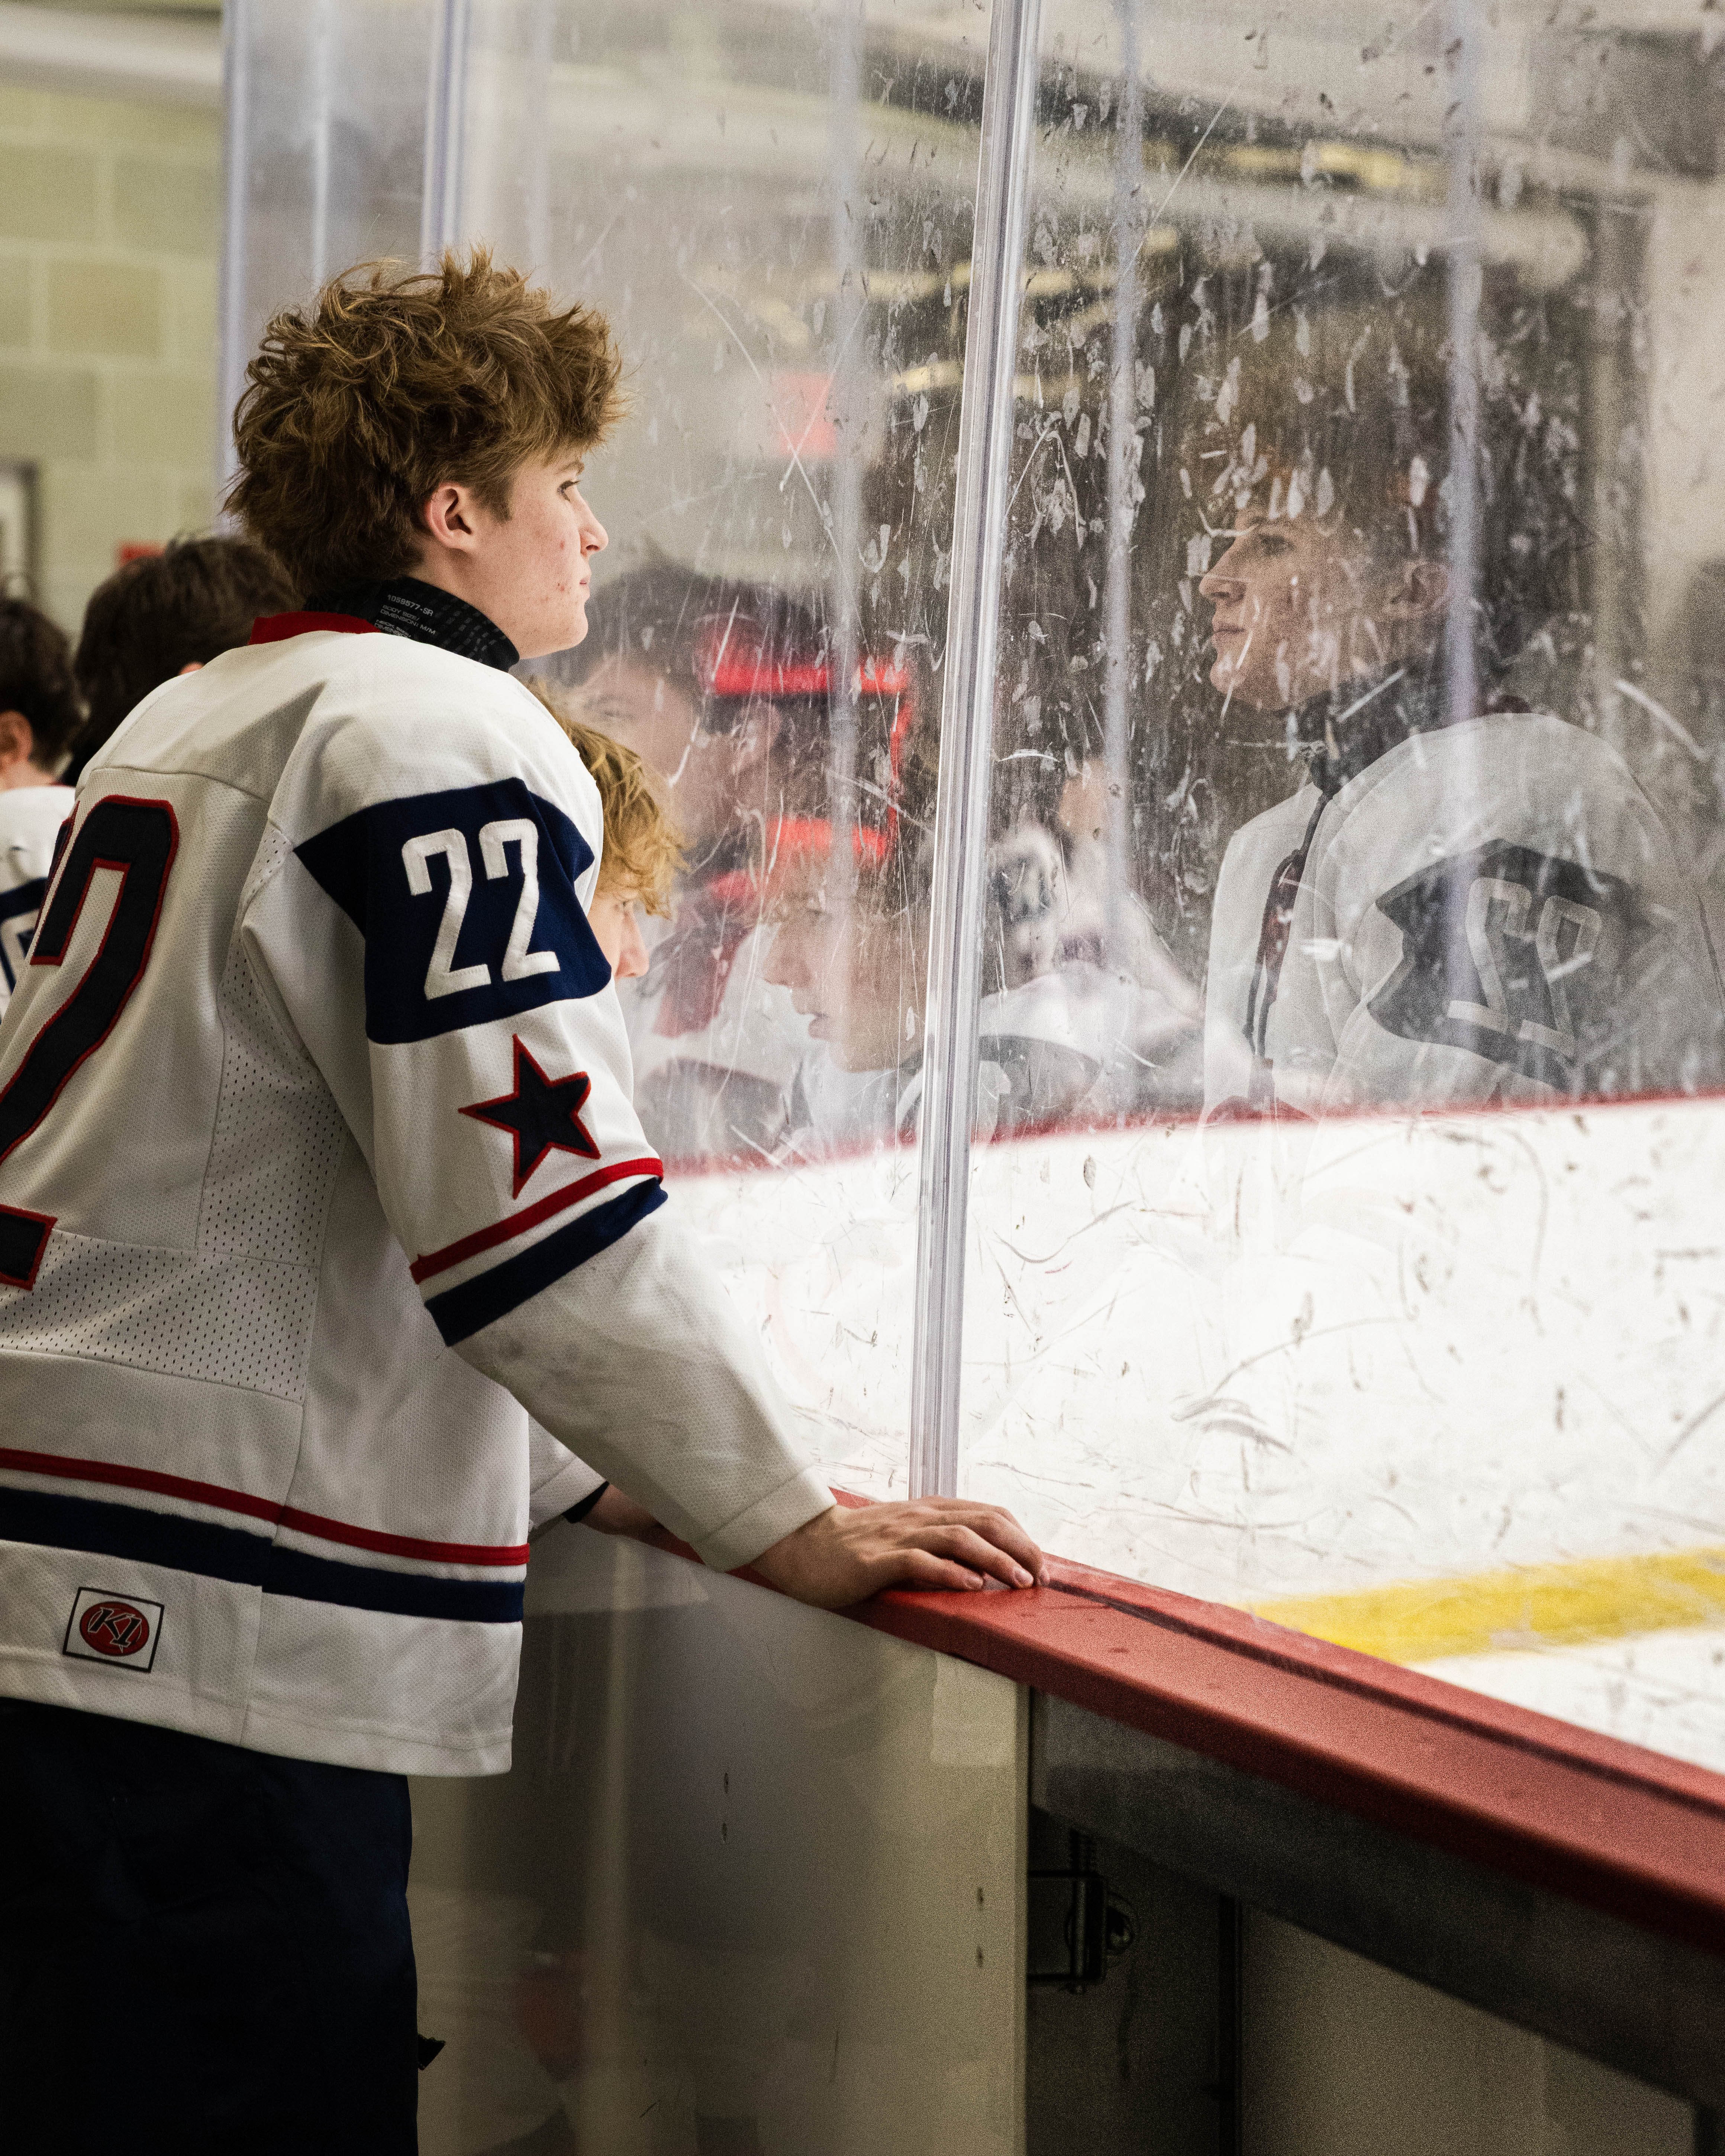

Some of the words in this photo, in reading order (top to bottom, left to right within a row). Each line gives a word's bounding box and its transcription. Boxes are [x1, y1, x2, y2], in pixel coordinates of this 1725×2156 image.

[383, 605, 401, 613] BODY
[403, 611, 419, 621] SIZE/
[376, 620, 394, 628] NECK
[380, 609, 419, 626] DIMENSION:
[420, 624, 435, 635] M/M
[375, 623, 408, 638] DIMENSIO
[402, 818, 561, 1000] 22
